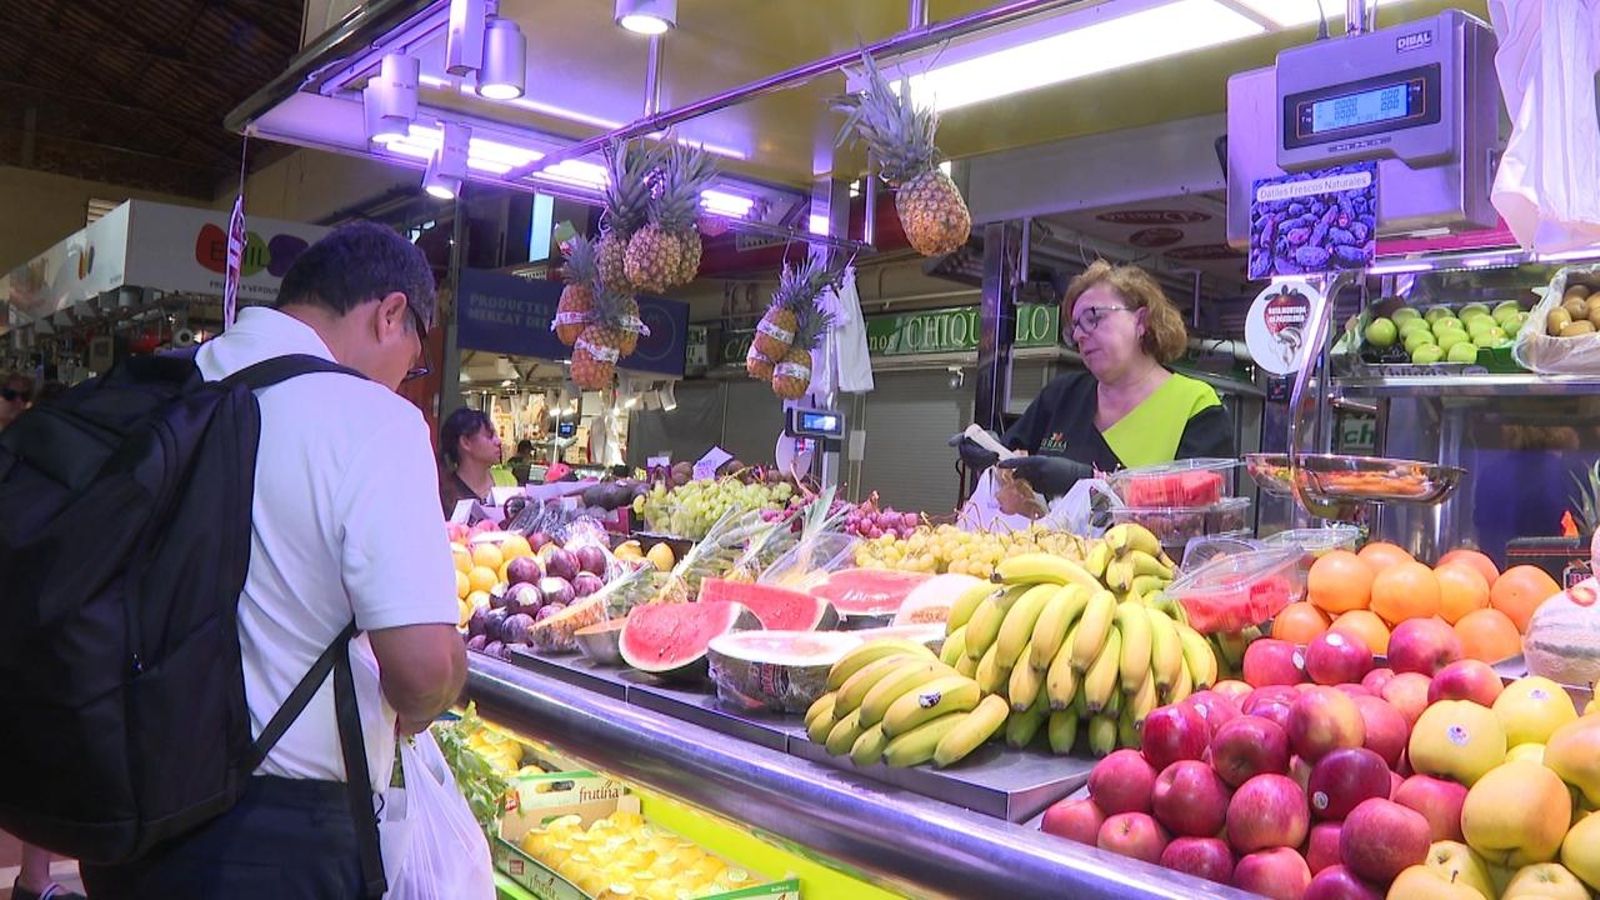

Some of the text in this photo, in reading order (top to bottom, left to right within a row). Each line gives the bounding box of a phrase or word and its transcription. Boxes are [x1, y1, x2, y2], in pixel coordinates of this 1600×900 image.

[1397, 32, 1432, 50] DIBAL
[1324, 177, 1367, 190] Naturales
[467, 307, 521, 326] MERCAT
[579, 782, 620, 804] frutina
